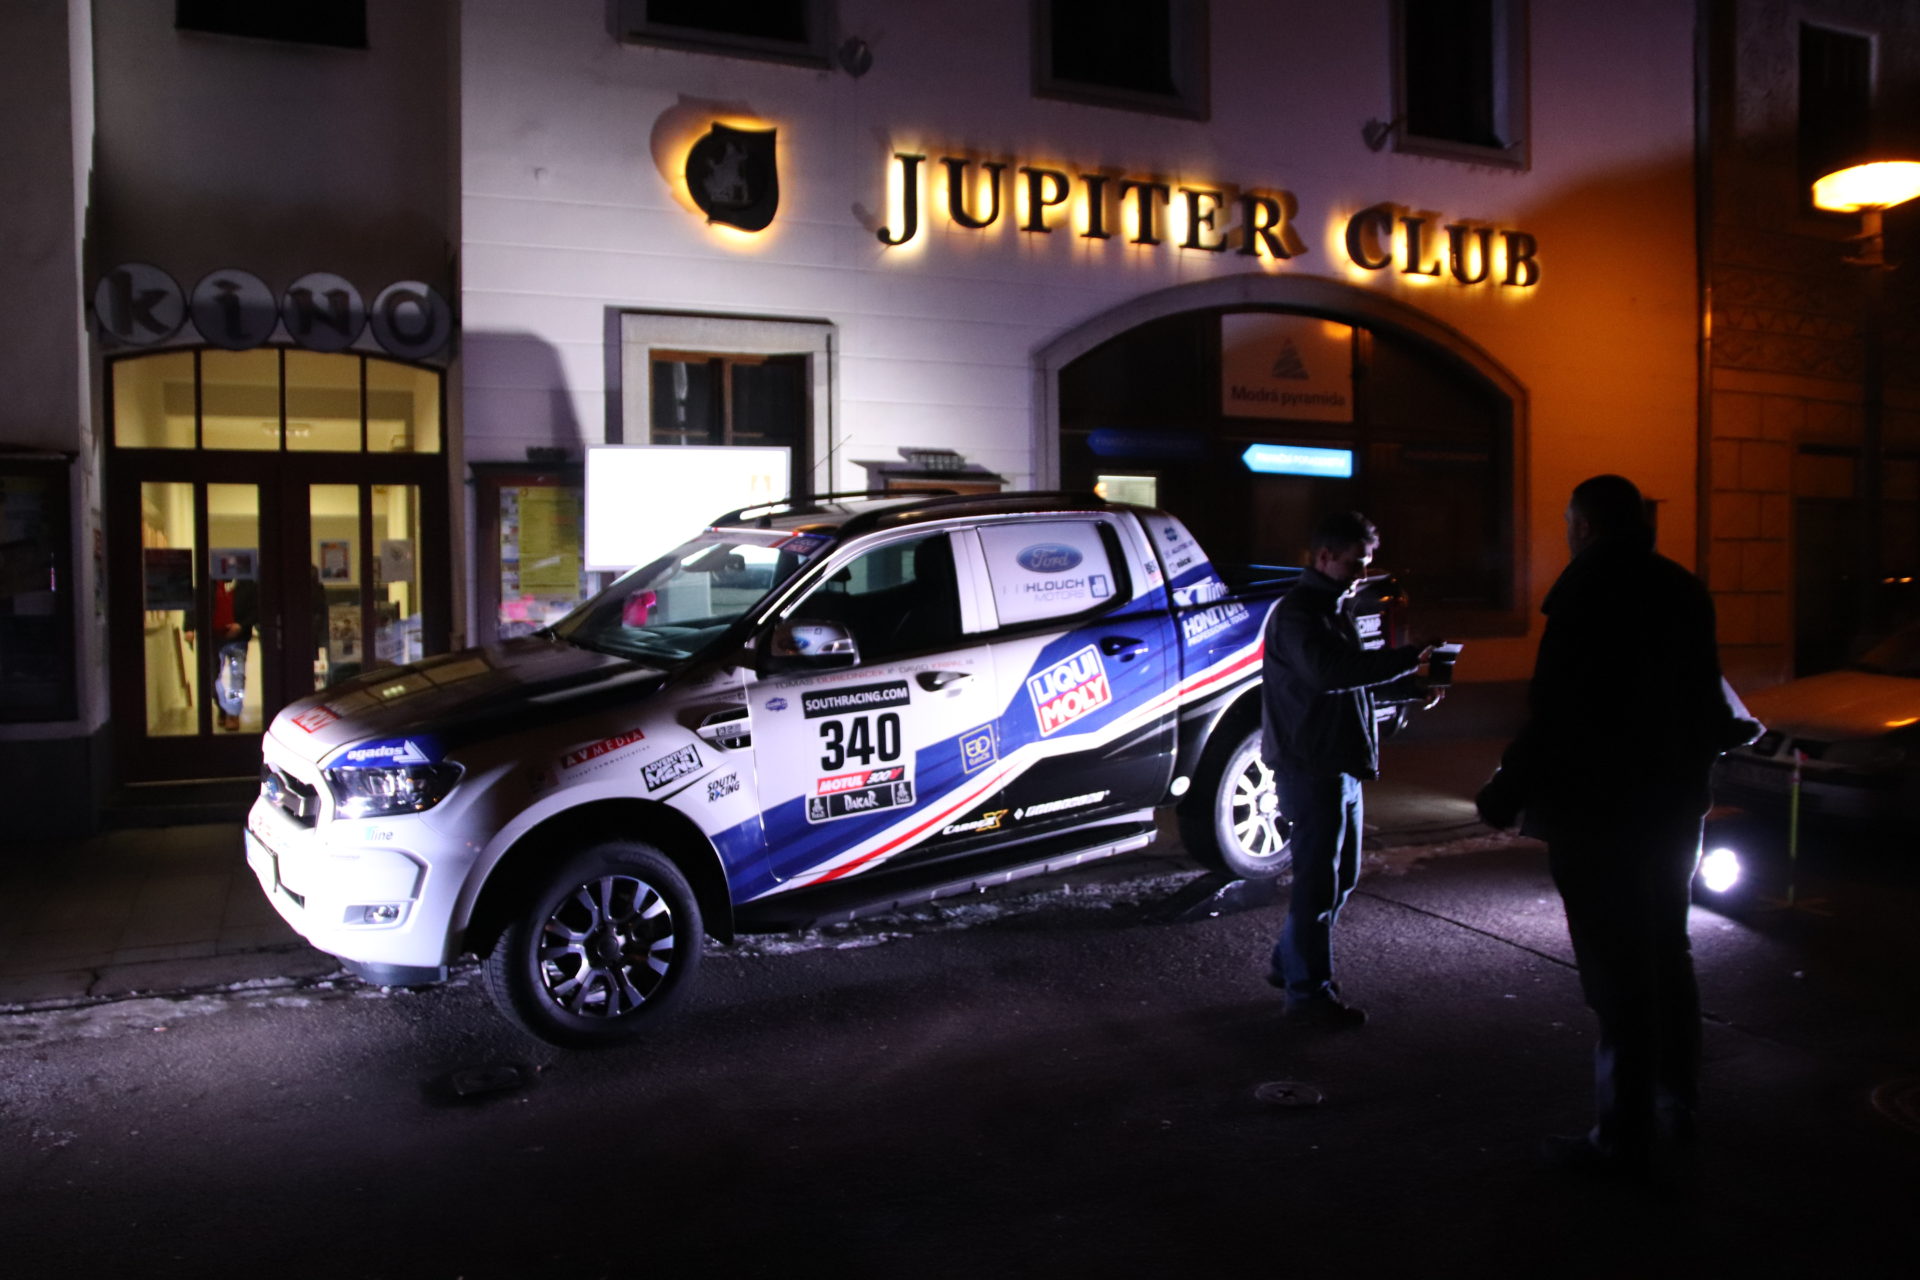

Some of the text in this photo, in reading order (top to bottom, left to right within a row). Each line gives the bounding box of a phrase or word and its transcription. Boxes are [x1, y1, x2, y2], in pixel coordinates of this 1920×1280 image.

[876, 153, 1540, 288] JUPITER CLUB
[1281, 389, 1346, 408] pyramida
[1031, 548, 1070, 569] Ford
[1026, 578, 1085, 593] HLOUCH
[1032, 650, 1100, 705] LIQUI
[804, 687, 909, 712] SOUTHRACING.COM
[1038, 678, 1105, 732] MOLY
[347, 746, 405, 762] agados
[819, 712, 902, 771] 340
[643, 745, 697, 774] ADVENTURE
[646, 750, 702, 788] MENU
[707, 772, 737, 793] SOUTH
[818, 775, 864, 793] MOTUL
